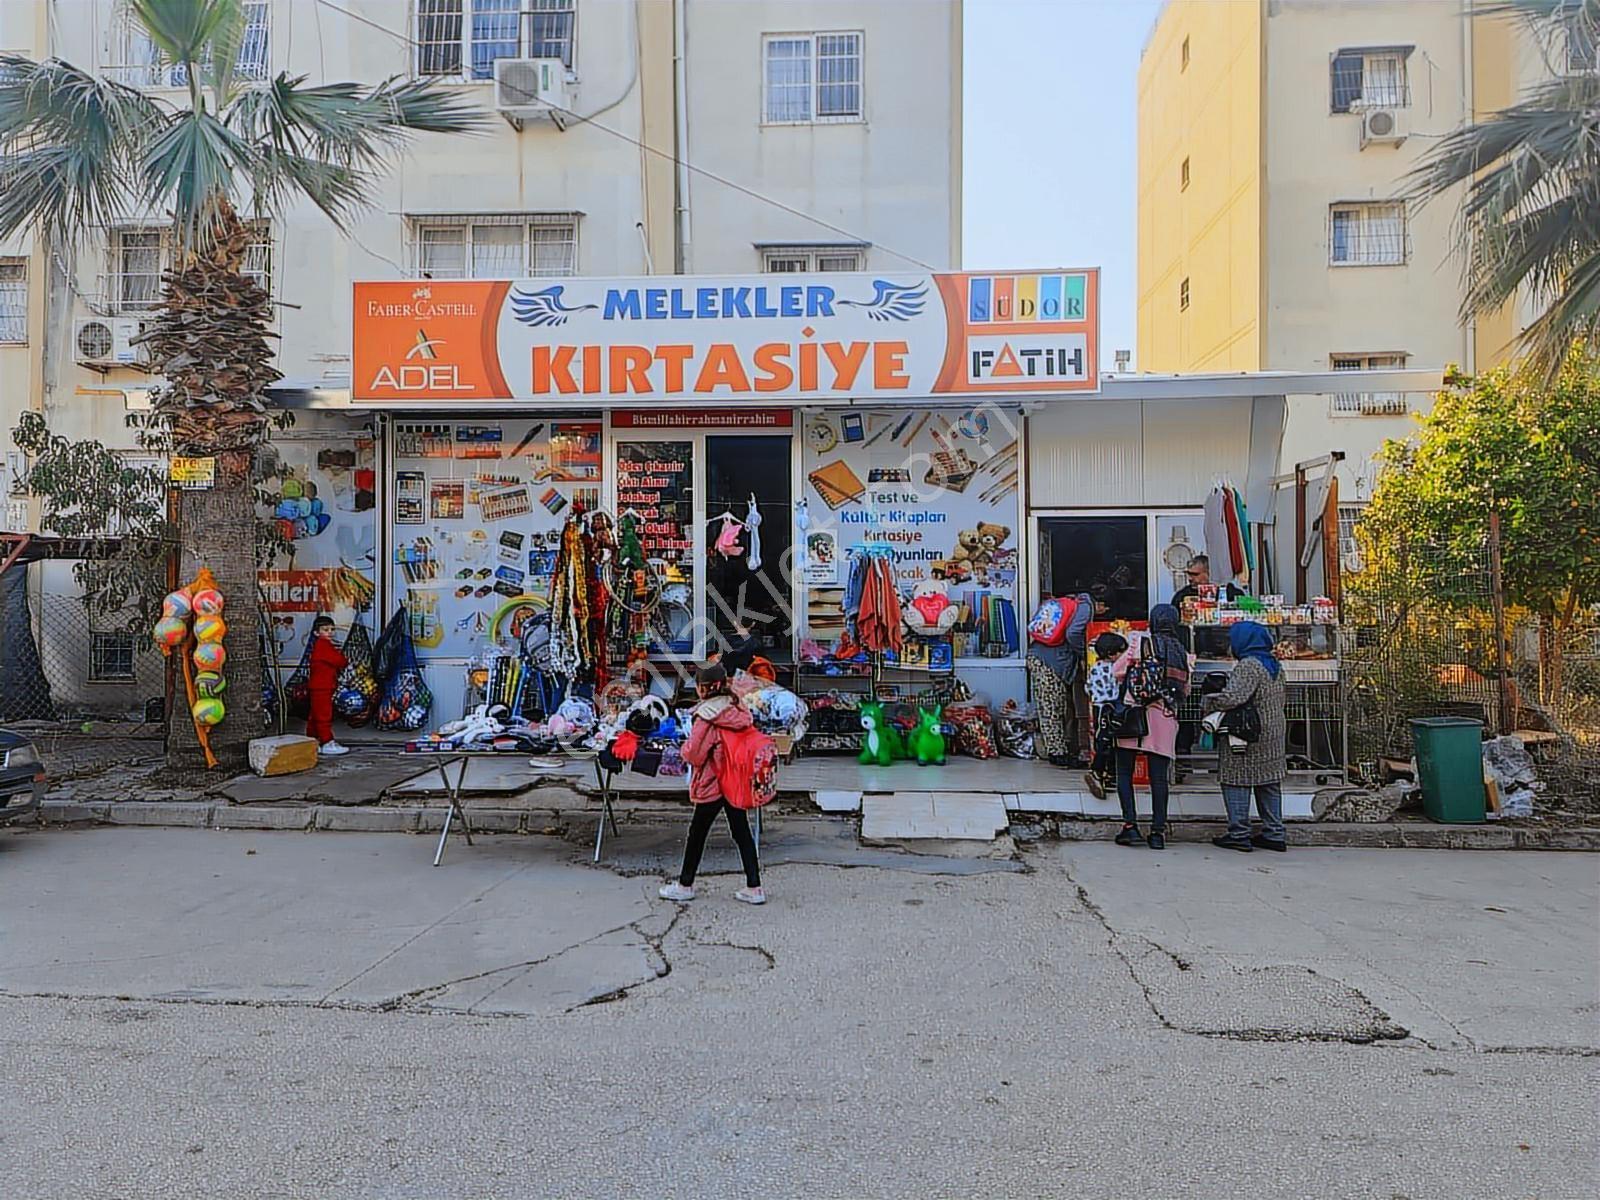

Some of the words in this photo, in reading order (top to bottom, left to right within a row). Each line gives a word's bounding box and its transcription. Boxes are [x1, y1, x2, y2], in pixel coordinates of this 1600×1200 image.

[603, 286, 836, 320] MELEKLER
[974, 296, 1081, 318] SÜDOR
[532, 326, 911, 395] KIRTASİYE
[369, 365, 475, 390] ADEL
[632, 413, 776, 425] Bismillahirrahmanirrahim
[870, 491, 898, 504] Test
[901, 493, 919, 504] ve
[841, 510, 886, 523] Kültür
[889, 510, 946, 526] Kitapları
[864, 529, 923, 545] Kırtasiye
